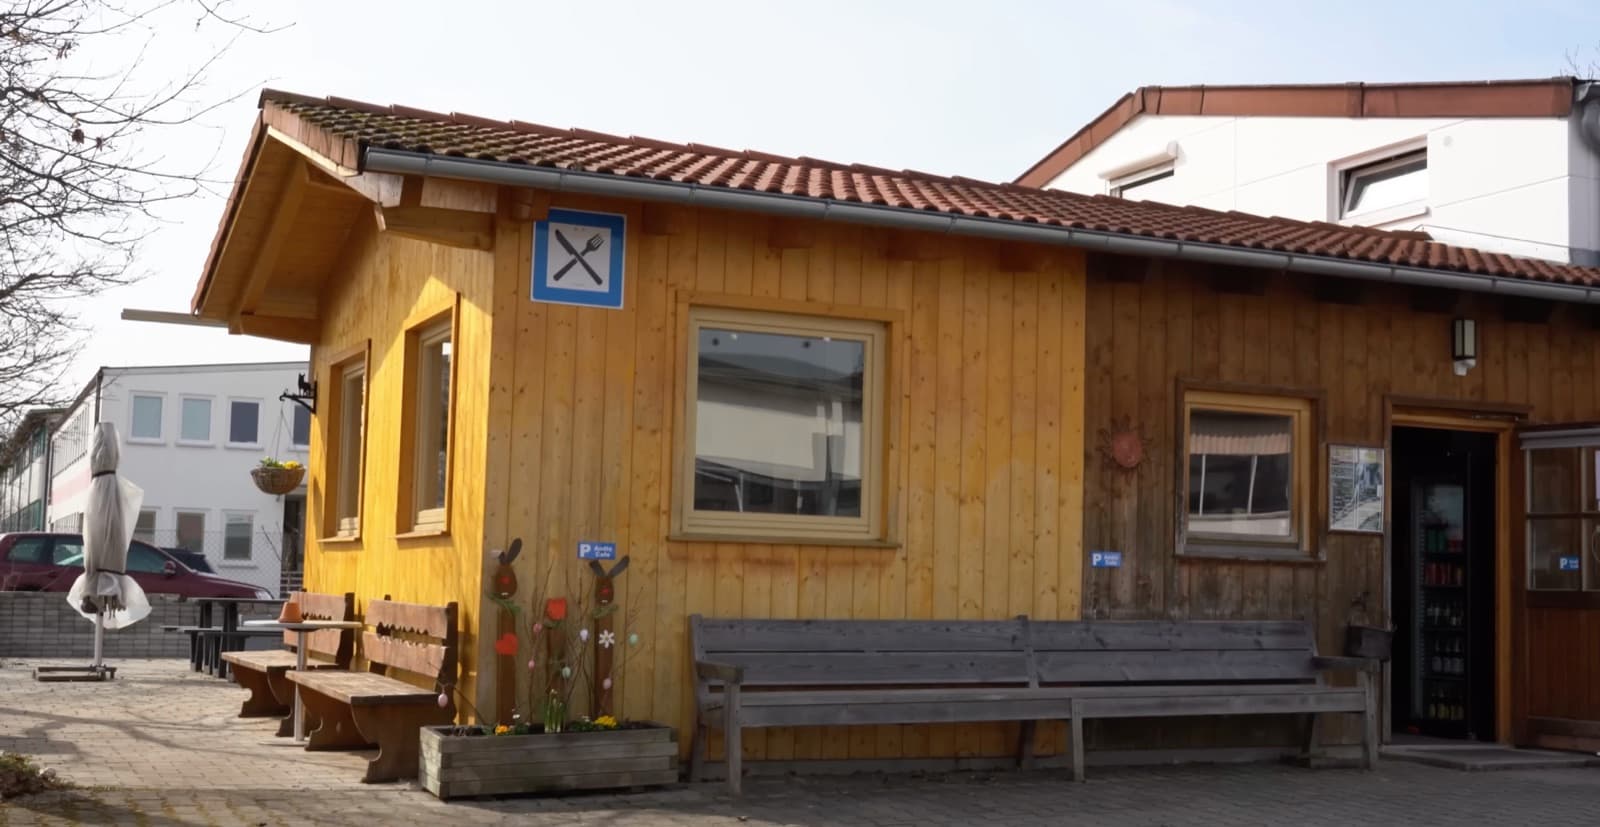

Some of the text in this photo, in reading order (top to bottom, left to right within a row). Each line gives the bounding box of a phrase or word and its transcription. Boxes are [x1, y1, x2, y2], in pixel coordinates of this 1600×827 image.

[579, 543, 591, 558] P
[1092, 552, 1102, 566] P
[1560, 557, 1568, 569] P
